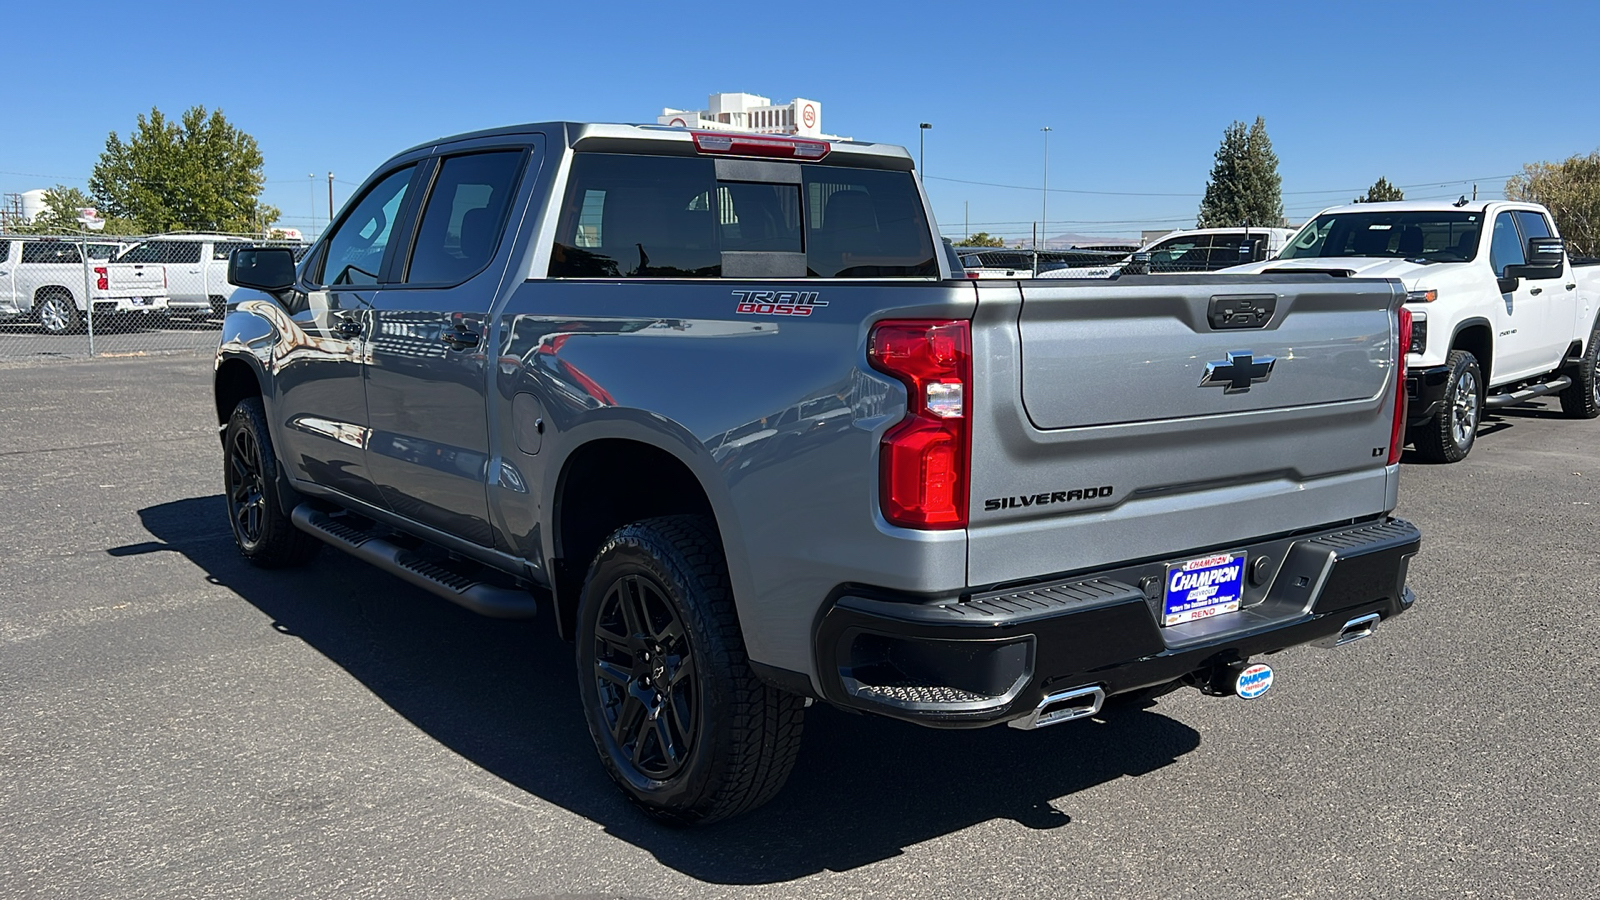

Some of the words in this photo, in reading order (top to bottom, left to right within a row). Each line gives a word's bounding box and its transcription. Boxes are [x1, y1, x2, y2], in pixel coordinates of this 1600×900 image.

[731, 289, 830, 307] TRAIL
[736, 303, 815, 317] BOSS
[1371, 446, 1386, 457] LT
[984, 485, 1114, 511] SILVERADO
[1189, 555, 1228, 570] CHAMPION
[1170, 565, 1240, 593] CHAMPION
[1189, 587, 1217, 599] CHEVROLET
[1191, 607, 1216, 619] RENO
